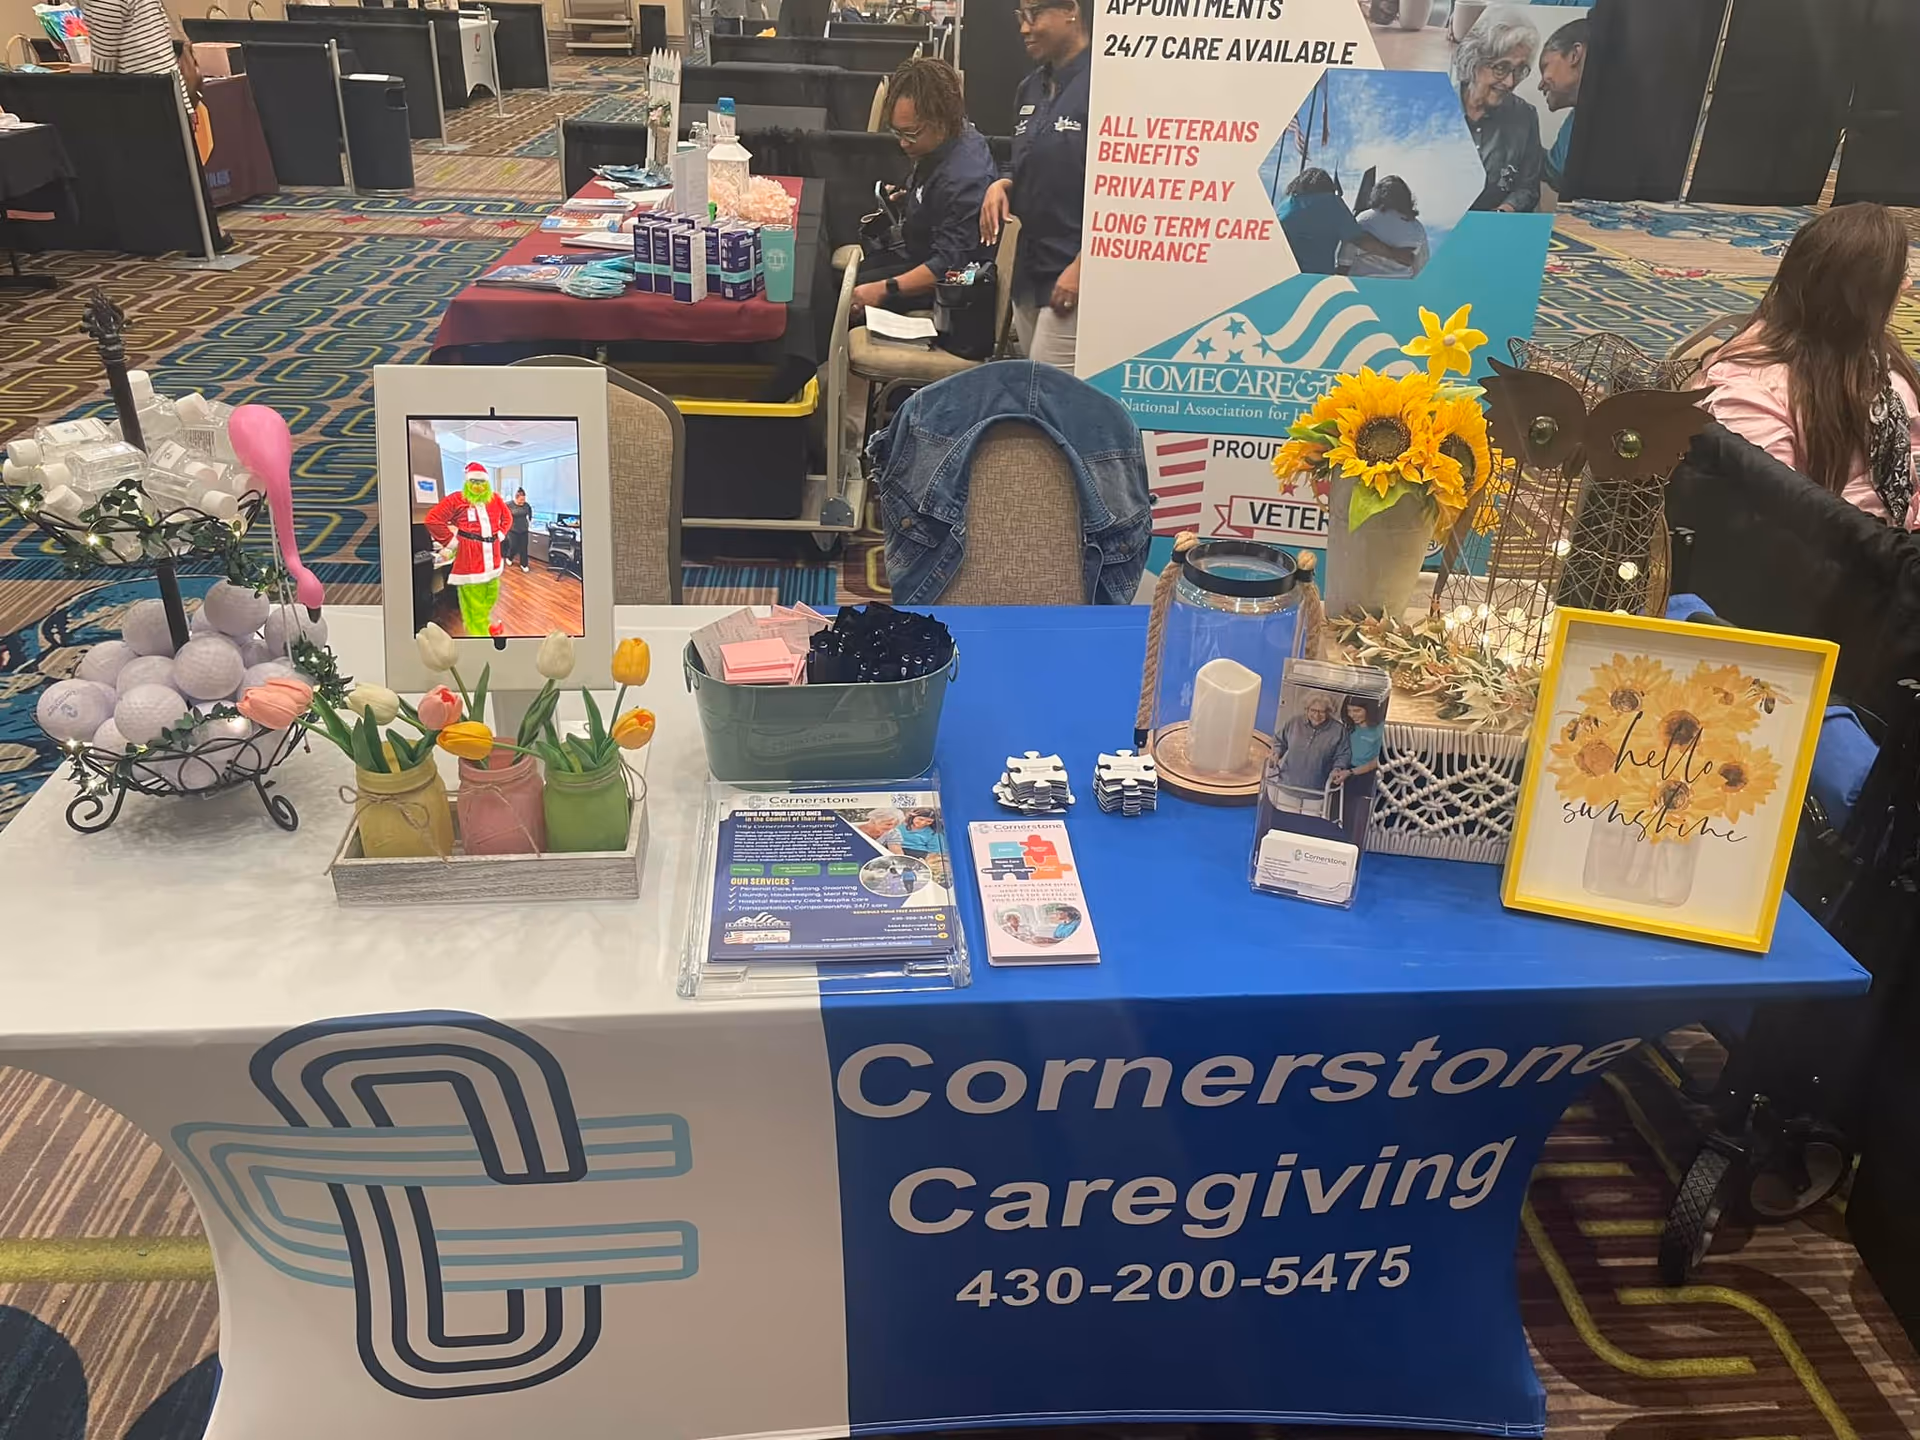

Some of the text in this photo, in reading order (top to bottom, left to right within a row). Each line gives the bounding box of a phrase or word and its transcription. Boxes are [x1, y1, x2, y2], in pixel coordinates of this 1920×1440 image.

[1106, 0, 1282, 19] APPOINTMENTS
[1104, 34, 1358, 65] 24/7 CARE AVAILABLE
[1099, 115, 1138, 138] ALL
[1146, 117, 1259, 143] VETERANS
[1098, 141, 1200, 167] BENEFITS
[1094, 174, 1235, 202] PRIVATE PAY
[1092, 211, 1274, 241] LONG TERM CARE
[1090, 236, 1211, 263] INSURANCE
[1120, 397, 1179, 414] National
[1184, 402, 1263, 419] Association
[1269, 405, 1288, 420] for
[1614, 711, 1713, 784] hello
[769, 795, 859, 804] Cornerstone
[1562, 784, 1748, 843] sunshine
[1304, 852, 1346, 866] Cornerstone
[730, 877, 749, 886] OUR
[750, 877, 790, 886] SERVICES
[836, 1035, 1642, 1118] Cornerstone
[889, 1136, 1516, 1239] Caregiving
[956, 1245, 1412, 1308] 430-200-5475
